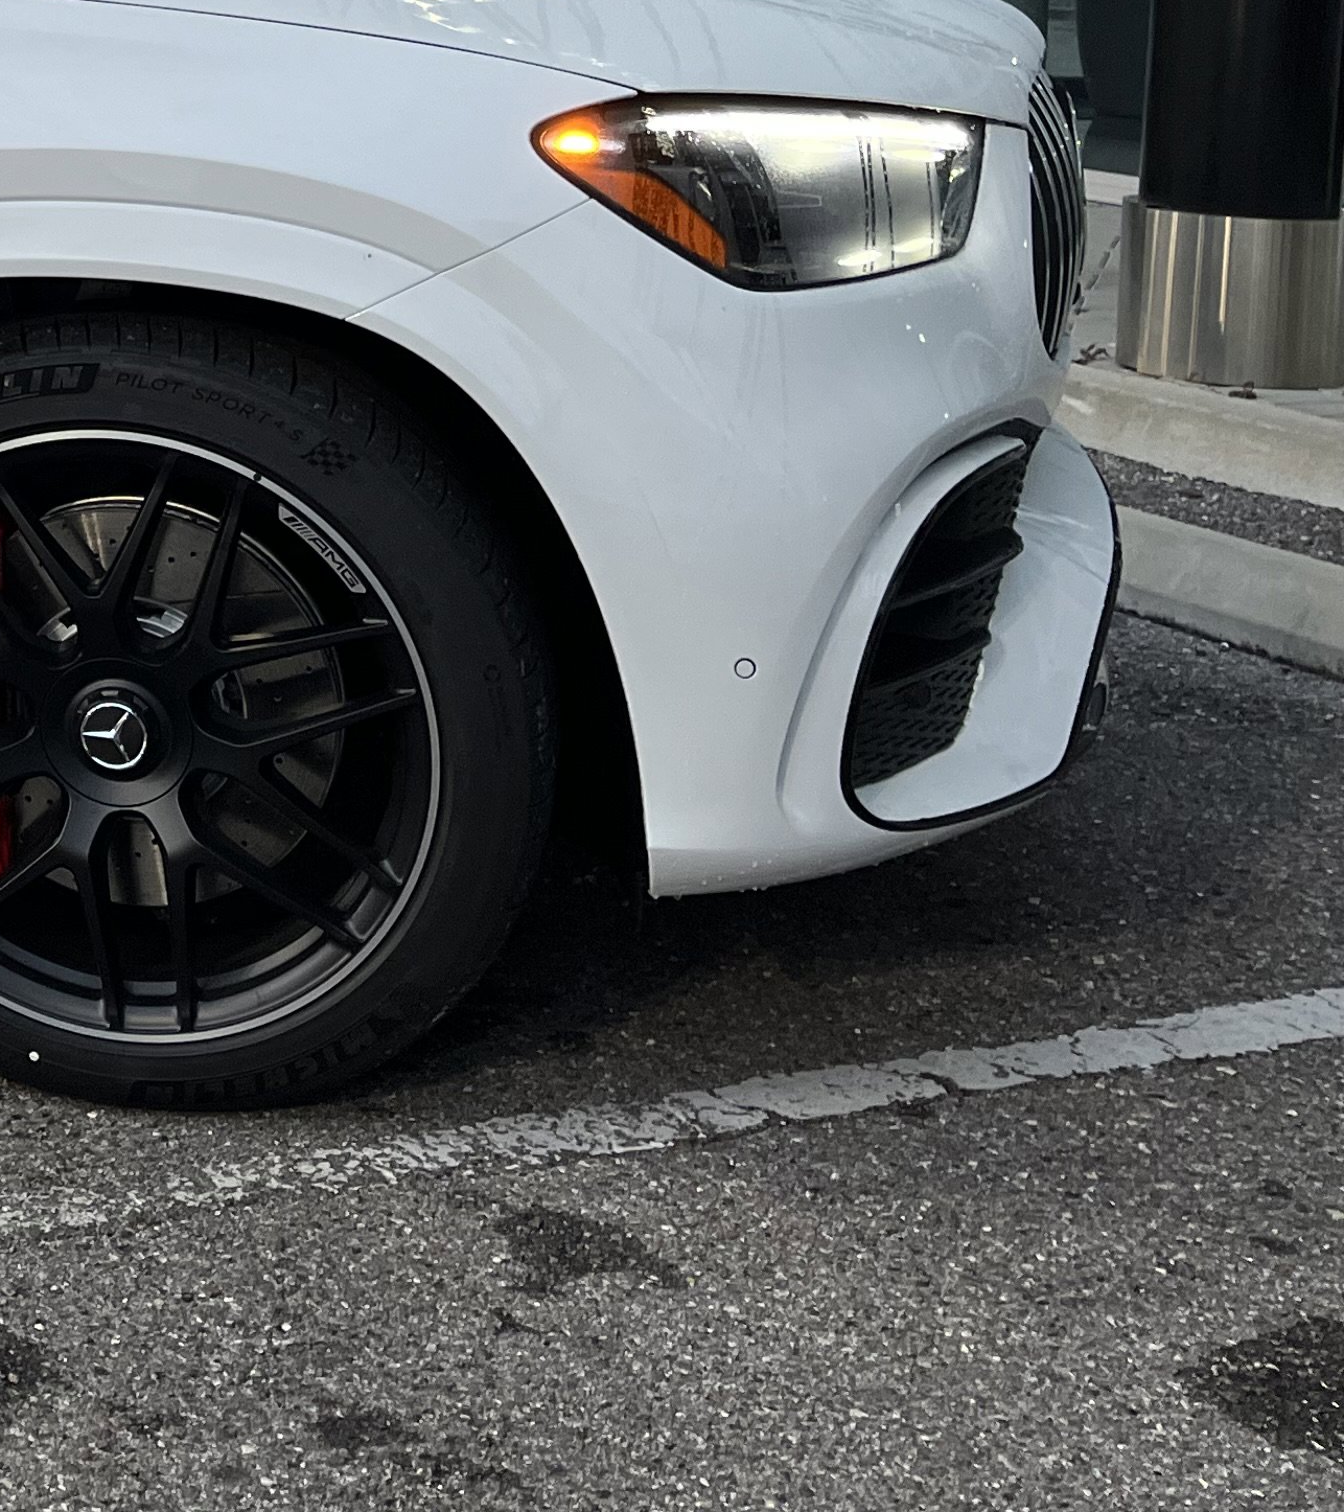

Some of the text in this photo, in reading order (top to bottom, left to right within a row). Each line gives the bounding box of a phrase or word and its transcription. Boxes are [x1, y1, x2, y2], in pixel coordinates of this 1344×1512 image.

[115, 372, 184, 393] PILOT
[190, 387, 272, 424] SPORT
[305, 534, 360, 590] AMG
